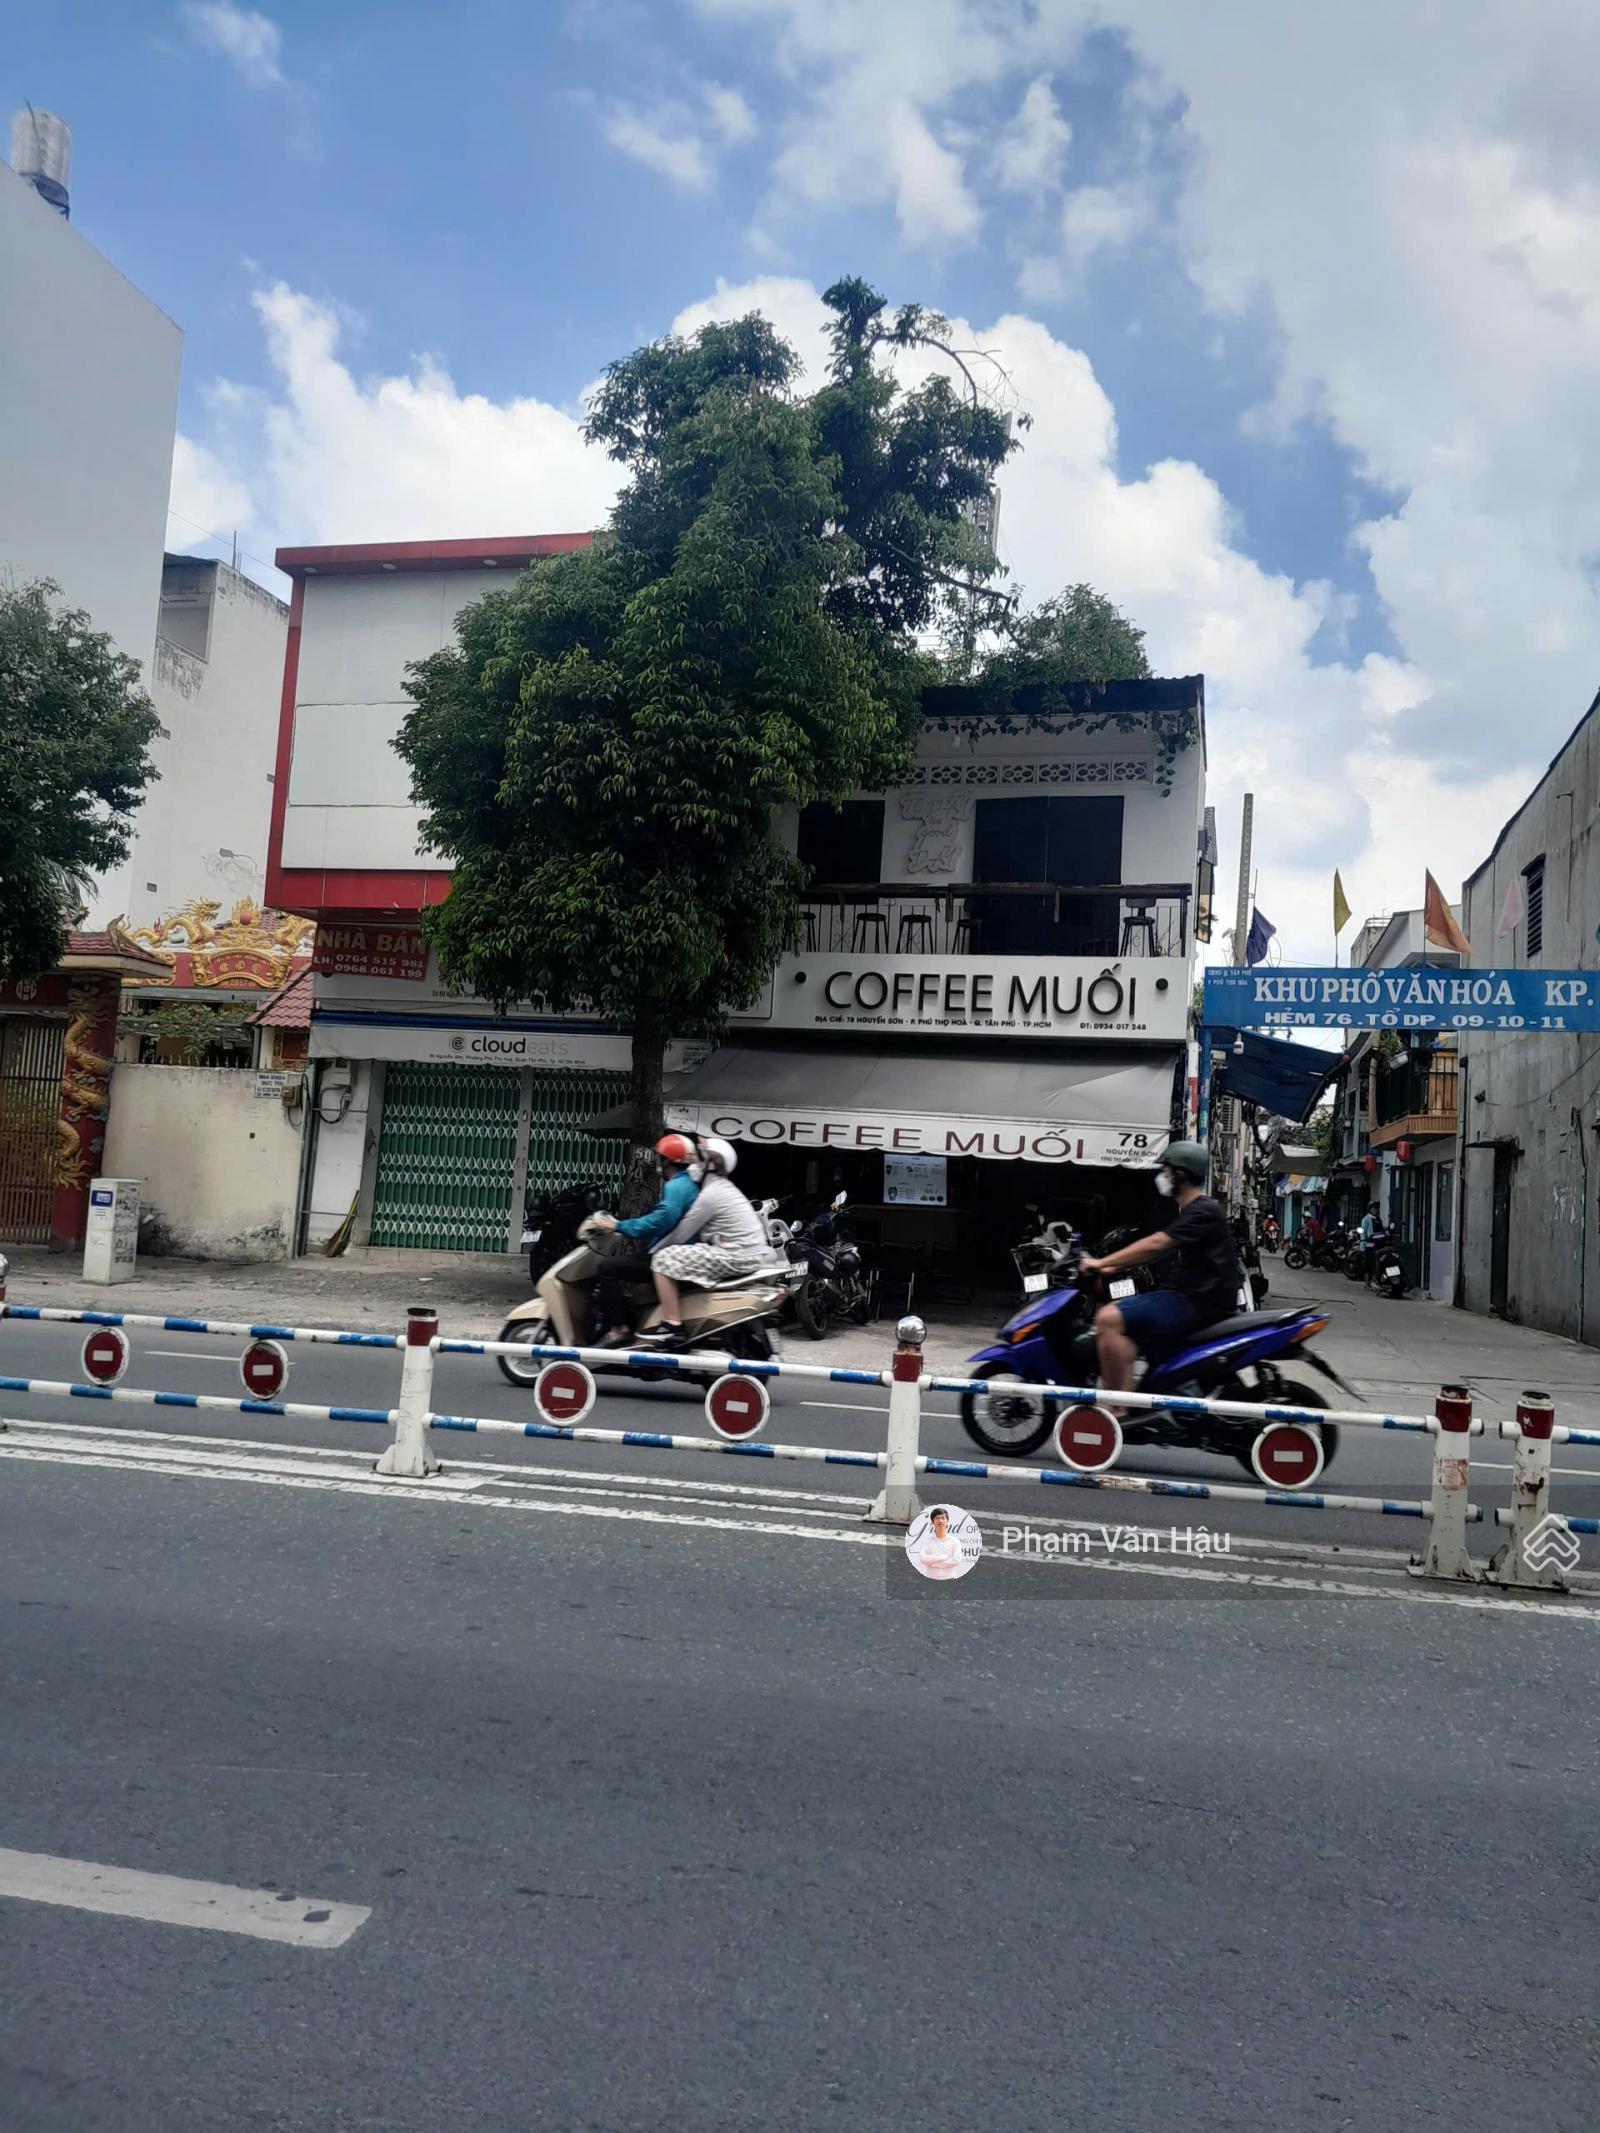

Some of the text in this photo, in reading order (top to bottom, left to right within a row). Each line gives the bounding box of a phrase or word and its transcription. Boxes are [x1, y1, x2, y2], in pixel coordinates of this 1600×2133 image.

[317, 927, 428, 955] NHÀ BÁN
[313, 956, 334, 965] LH:
[336, 954, 368, 964] 0764
[372, 956, 397, 966] 515
[334, 963, 422, 977] 0968 061 199
[824, 963, 1136, 1016] COFFEE MUỐI
[1254, 970, 1594, 1007] KHU PHỐ VĂN HÓA KP.
[1131, 1023, 1147, 1031] 248
[1323, 1013, 1352, 1025] 76
[1403, 1015, 1436, 1027] DP
[471, 1035, 569, 1056] cloudeats
[711, 1116, 922, 1149] COFFEE
[945, 1129, 1084, 1159] MUỐI
[1118, 1132, 1148, 1148] 78
